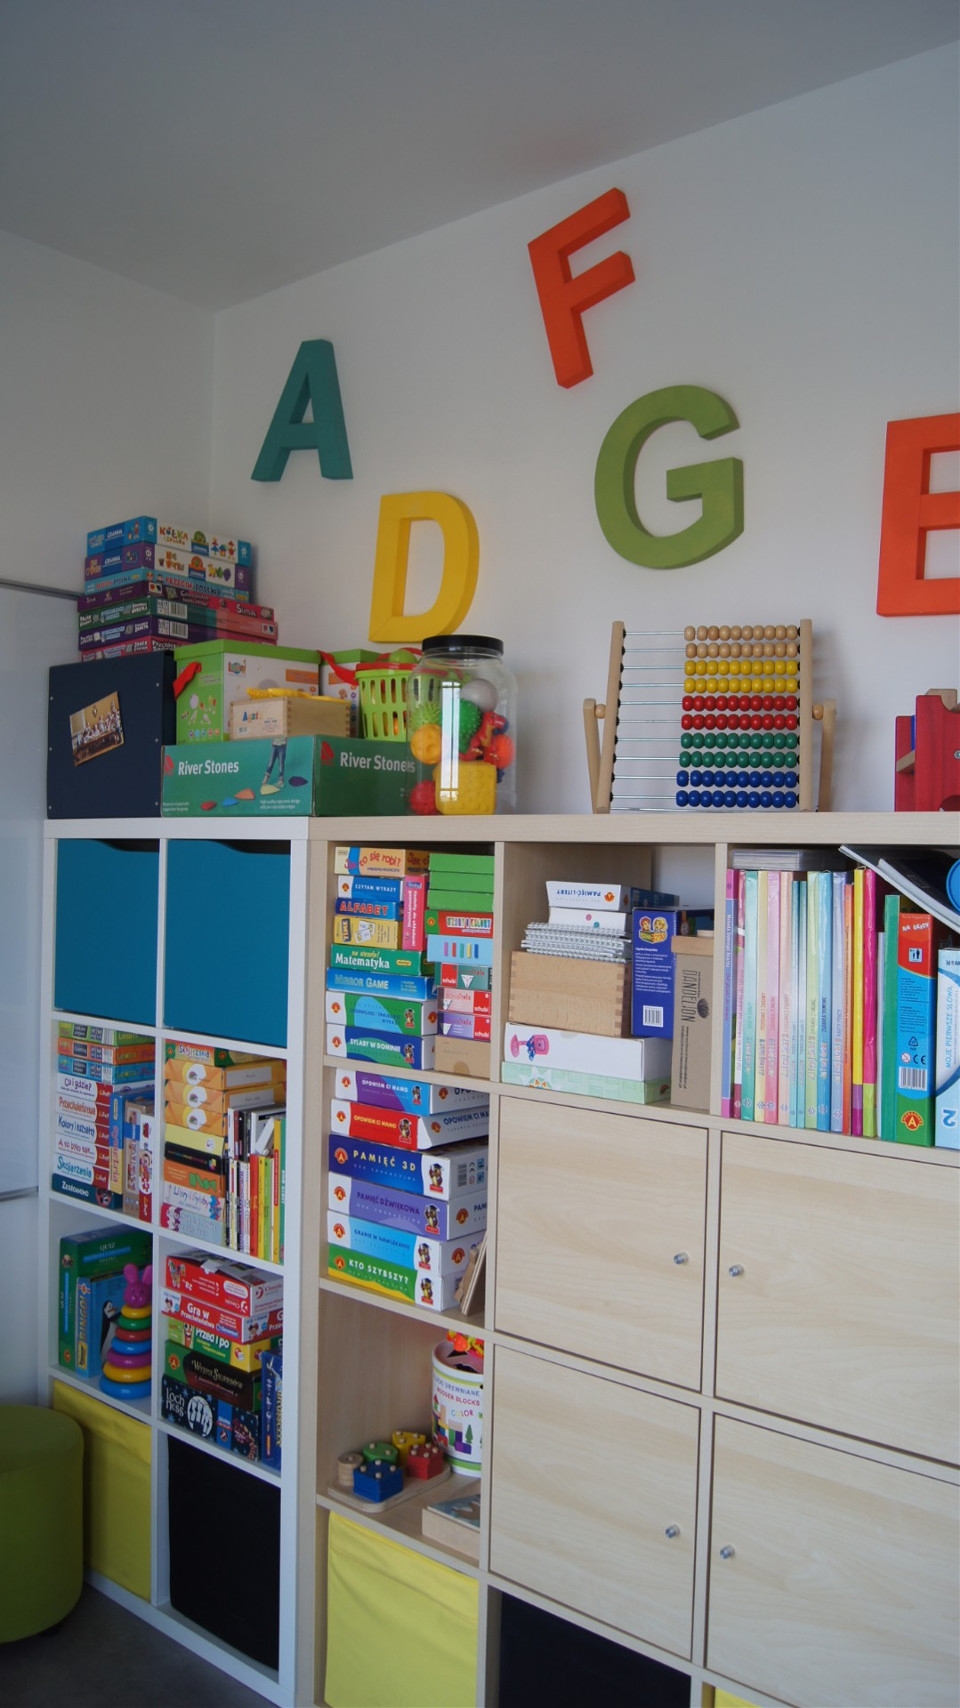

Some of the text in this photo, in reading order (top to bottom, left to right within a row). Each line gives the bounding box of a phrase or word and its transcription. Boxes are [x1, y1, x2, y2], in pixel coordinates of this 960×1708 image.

[528, 187, 636, 390] F
[250, 339, 354, 482] A
[594, 384, 745, 570] G
[876, 412, 960, 618] E
[369, 490, 480, 644] D
[178, 759, 240, 776] River Stones
[340, 752, 416, 774] River Stones
[340, 901, 389, 916] ALFABET
[335, 953, 390, 970] Matematyka
[334, 974, 364, 988] MIRROR
[366, 977, 389, 990] GAME
[680, 970, 698, 1022] DANDELION
[354, 1150, 416, 1172] PAMIĘĆ 3D
[356, 1192, 380, 1206] PAMIĘĆ
[349, 1259, 365, 1271] KTO
[368, 1264, 409, 1284] SZYBSZY?
[79, 1295, 88, 1341] RINGO!
[187, 1302, 200, 1316] Gra
[218, 1338, 230, 1348] po
[166, 1388, 185, 1406] loch
[166, 1400, 184, 1417] ness
[450, 1408, 474, 1418] COLOR
